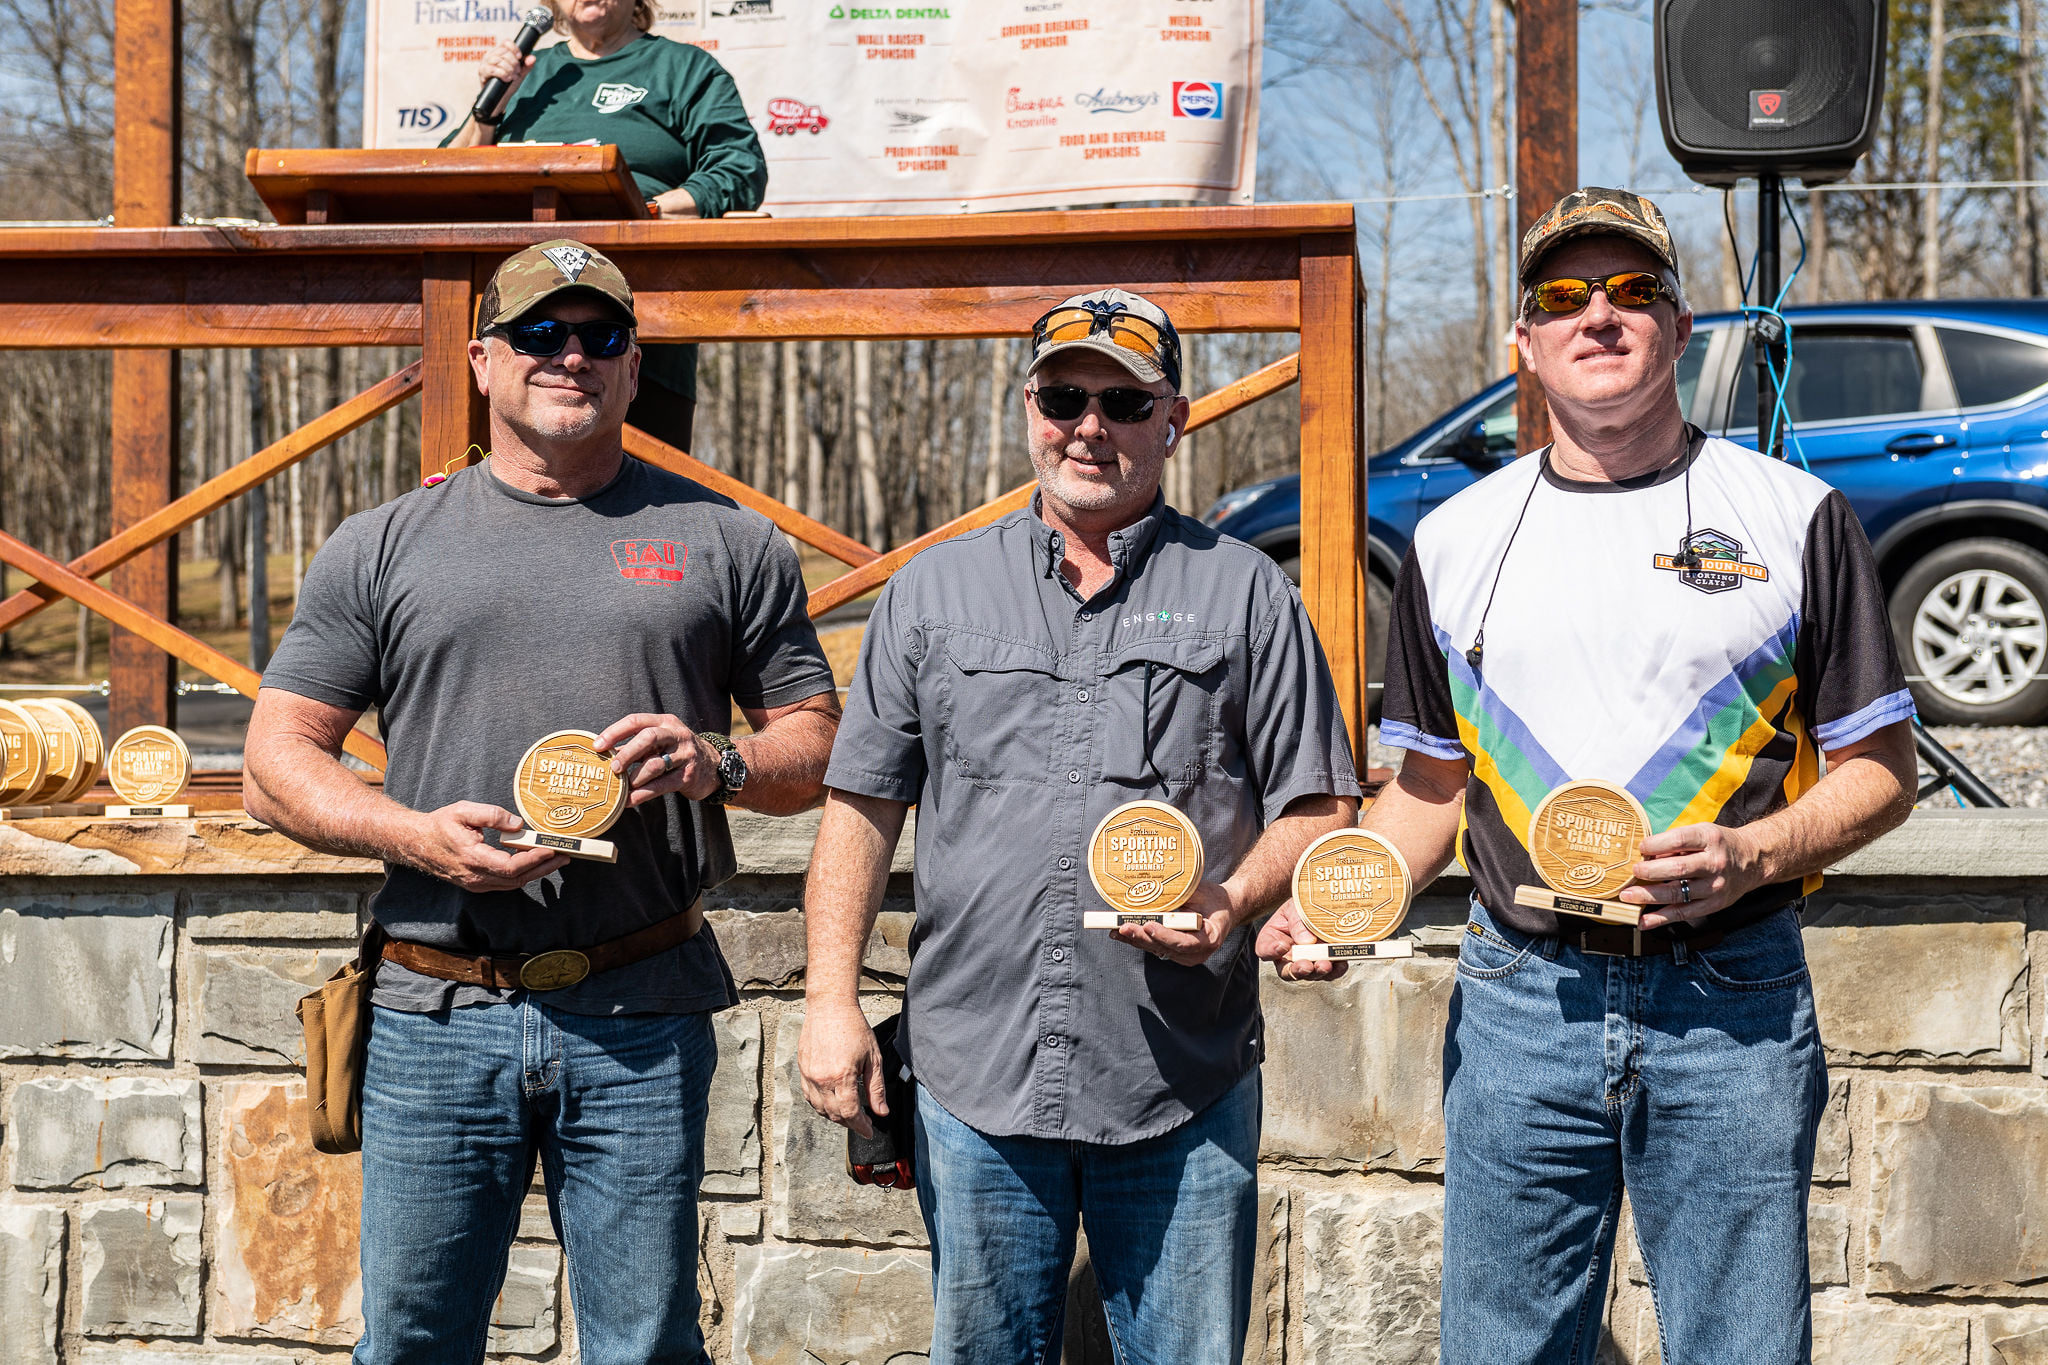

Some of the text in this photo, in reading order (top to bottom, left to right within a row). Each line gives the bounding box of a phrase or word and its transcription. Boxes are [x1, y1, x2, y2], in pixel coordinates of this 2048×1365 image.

[414, 0, 522, 24] FirstBank
[850, 8, 951, 20] DELTA DENTAL
[1169, 15, 1203, 27] MEDIA
[1002, 19, 1088, 37] GROUND BREAKER
[437, 36, 497, 48] PRESENTING
[1021, 35, 1068, 50] SPONSOR
[1160, 30, 1212, 42] SPONSOR
[443, 50, 487, 62] SPONSO
[866, 48, 916, 60] SPONSOR
[1074, 87, 1160, 114] Aubrey's
[1181, 94, 1215, 106] PEPSI
[398, 106, 433, 128] TIS
[1060, 130, 1166, 147] FOOD AND BEVERAGE
[884, 145, 960, 158] PROMOTIONAL
[1083, 145, 1142, 160] SPONSORS
[897, 160, 949, 172] SPONSOR
[1694, 579, 1726, 588] CLAYS
[123, 750, 172, 763] SPORTING
[132, 761, 164, 771] CLAYS
[540, 759, 605, 780] SPORTING
[549, 774, 590, 791] CLAYS
[548, 787, 589, 798] TOURNAMENT
[554, 807, 574, 818] 2022
[1555, 813, 1627, 837] SPORTING
[542, 839, 559, 847] SECOND
[1111, 836, 1177, 851] SPORTING
[1568, 828, 1611, 849] CLAYS
[1567, 843, 1611, 856] TOURNAMENT
[1123, 851, 1164, 864] CLAYS
[1123, 863, 1165, 871] TOURNAMENT
[1316, 863, 1384, 881] SPORTING
[1573, 866, 1594, 877] 2022
[1134, 883, 1153, 896] 2022
[1330, 880, 1372, 894] CLAYS
[1331, 892, 1373, 901] TOURNAMENT
[1560, 902, 1579, 911] SECOND
[1580, 905, 1595, 914] PLACE
[1353, 947, 1369, 956] PLACE
